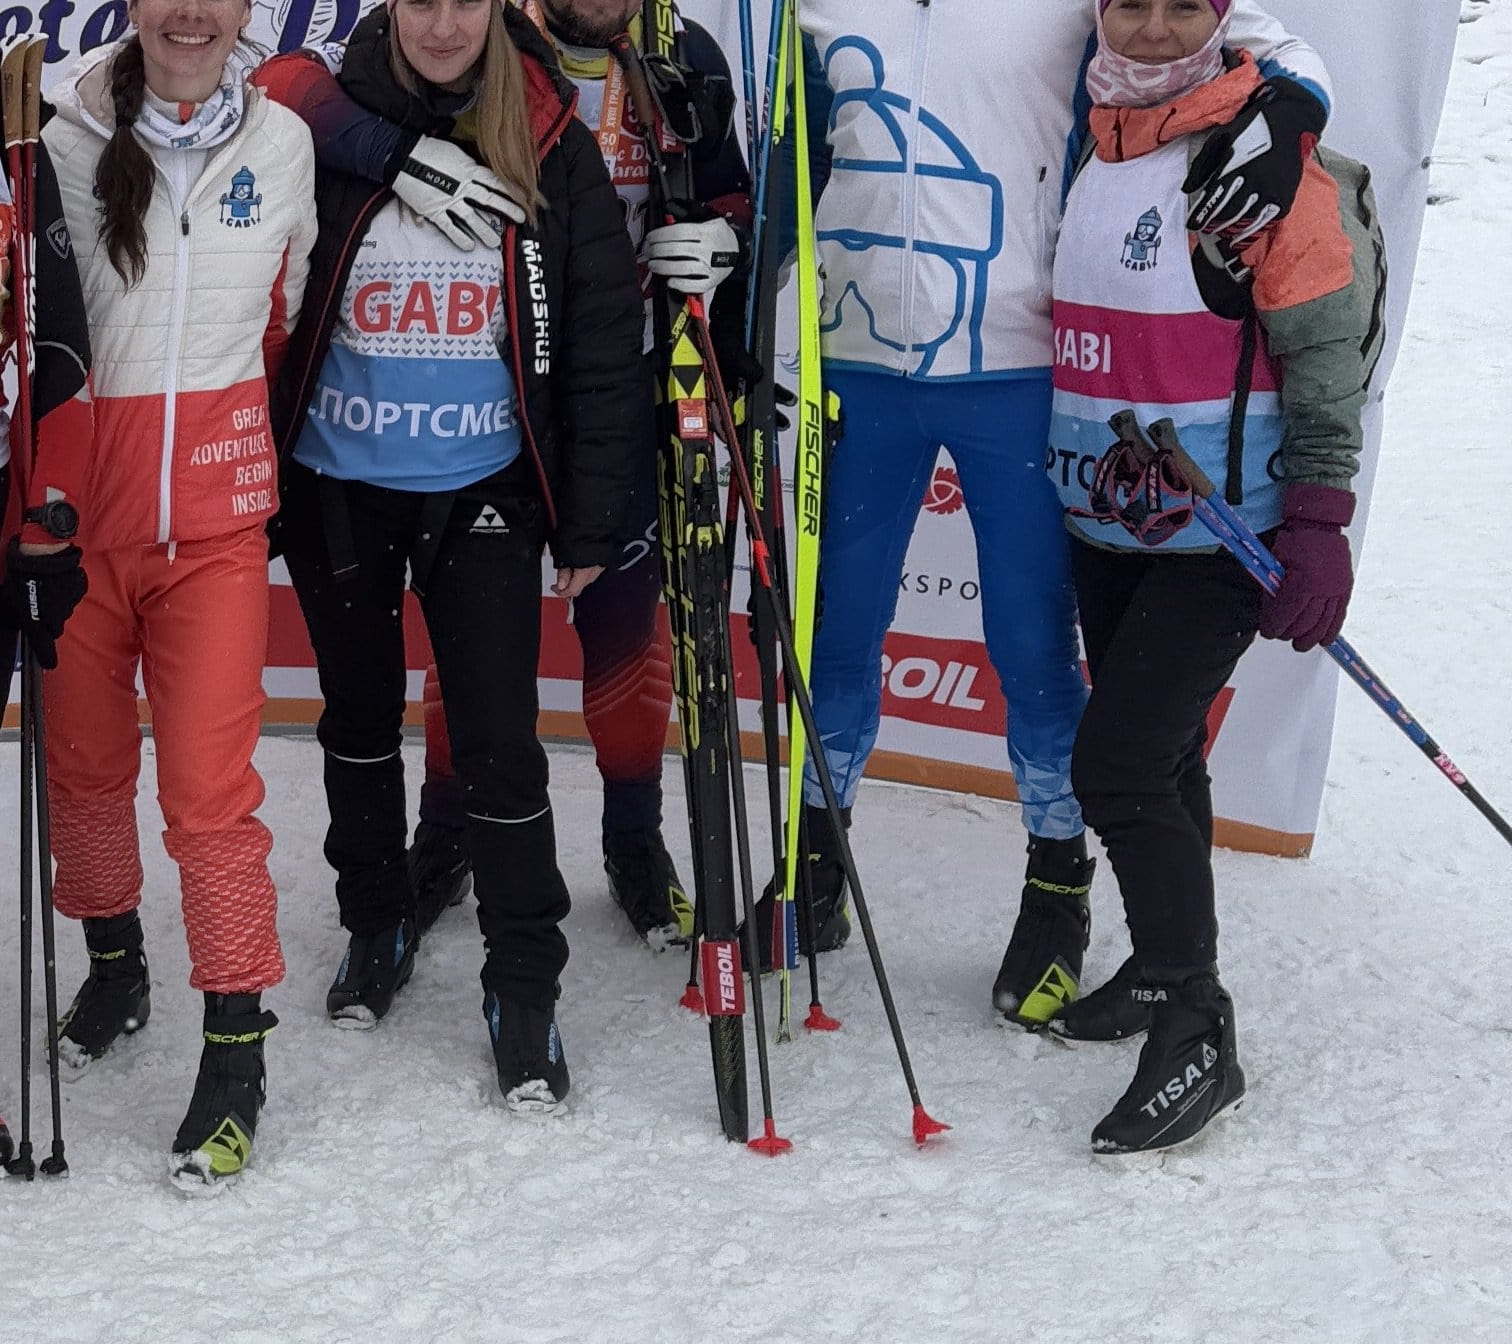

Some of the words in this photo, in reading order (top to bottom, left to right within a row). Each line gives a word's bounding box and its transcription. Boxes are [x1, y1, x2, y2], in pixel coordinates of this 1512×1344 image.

[600, 132, 618, 146] 50
[353, 280, 501, 336] GABI
[753, 428, 764, 512] FISCHER
[802, 399, 820, 537] FISCHER
[717, 942, 736, 1013] TEBOIL
[1131, 989, 1168, 1002] TISA
[1140, 1059, 1203, 1119] TISA
